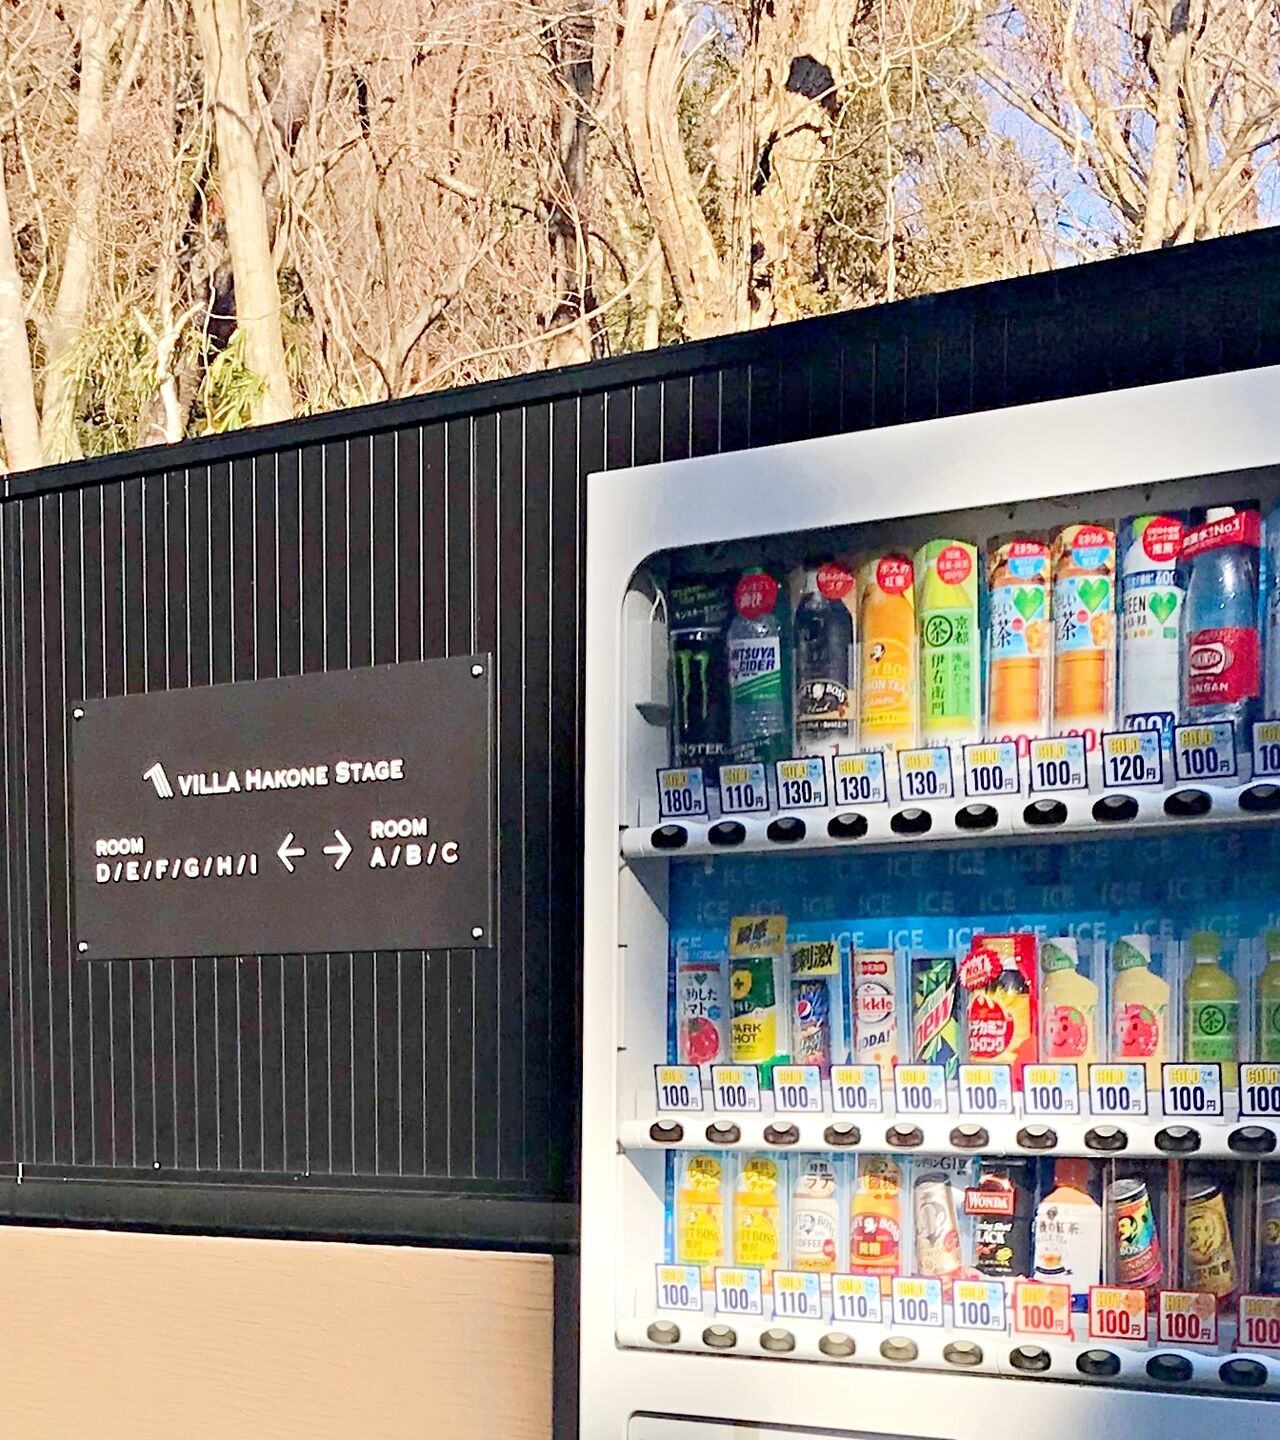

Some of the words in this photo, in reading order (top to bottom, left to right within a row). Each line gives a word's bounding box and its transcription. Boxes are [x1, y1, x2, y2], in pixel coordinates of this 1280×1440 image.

[928, 617, 951, 645] 茶
[740, 660, 775, 671] CIDER
[179, 772, 239, 797] VILLA
[246, 766, 328, 792] HAKONE
[335, 760, 404, 785] STAGE
[371, 818, 427, 839] ROOM
[96, 837, 144, 857] ROOM
[888, 930, 924, 951] ICE
[968, 1191, 1008, 1209] WONDA
[976, 1230, 1005, 1244] LACK
